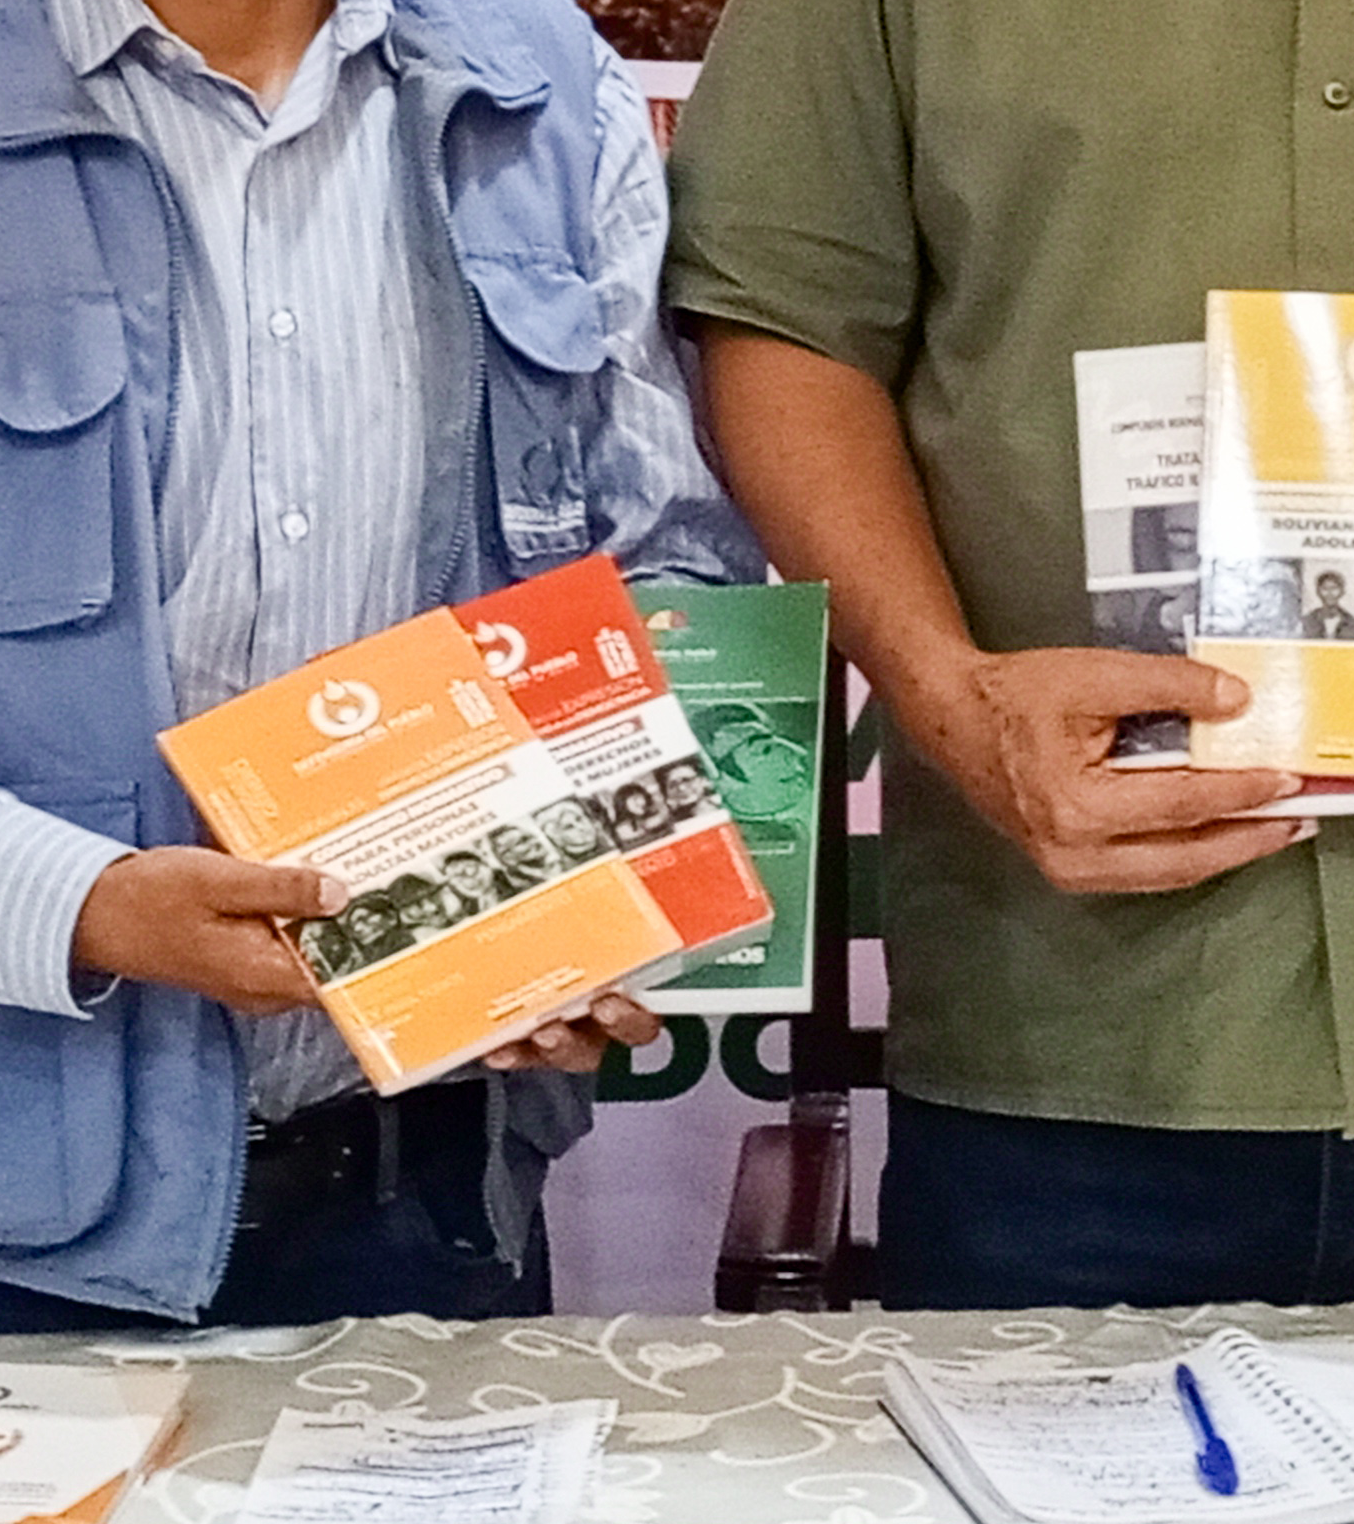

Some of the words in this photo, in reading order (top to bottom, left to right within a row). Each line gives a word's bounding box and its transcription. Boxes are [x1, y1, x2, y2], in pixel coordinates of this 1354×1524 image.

[342, 842, 389, 871] PARA
[392, 800, 479, 847] PERSONAS
[417, 809, 498, 854] MAYORES
